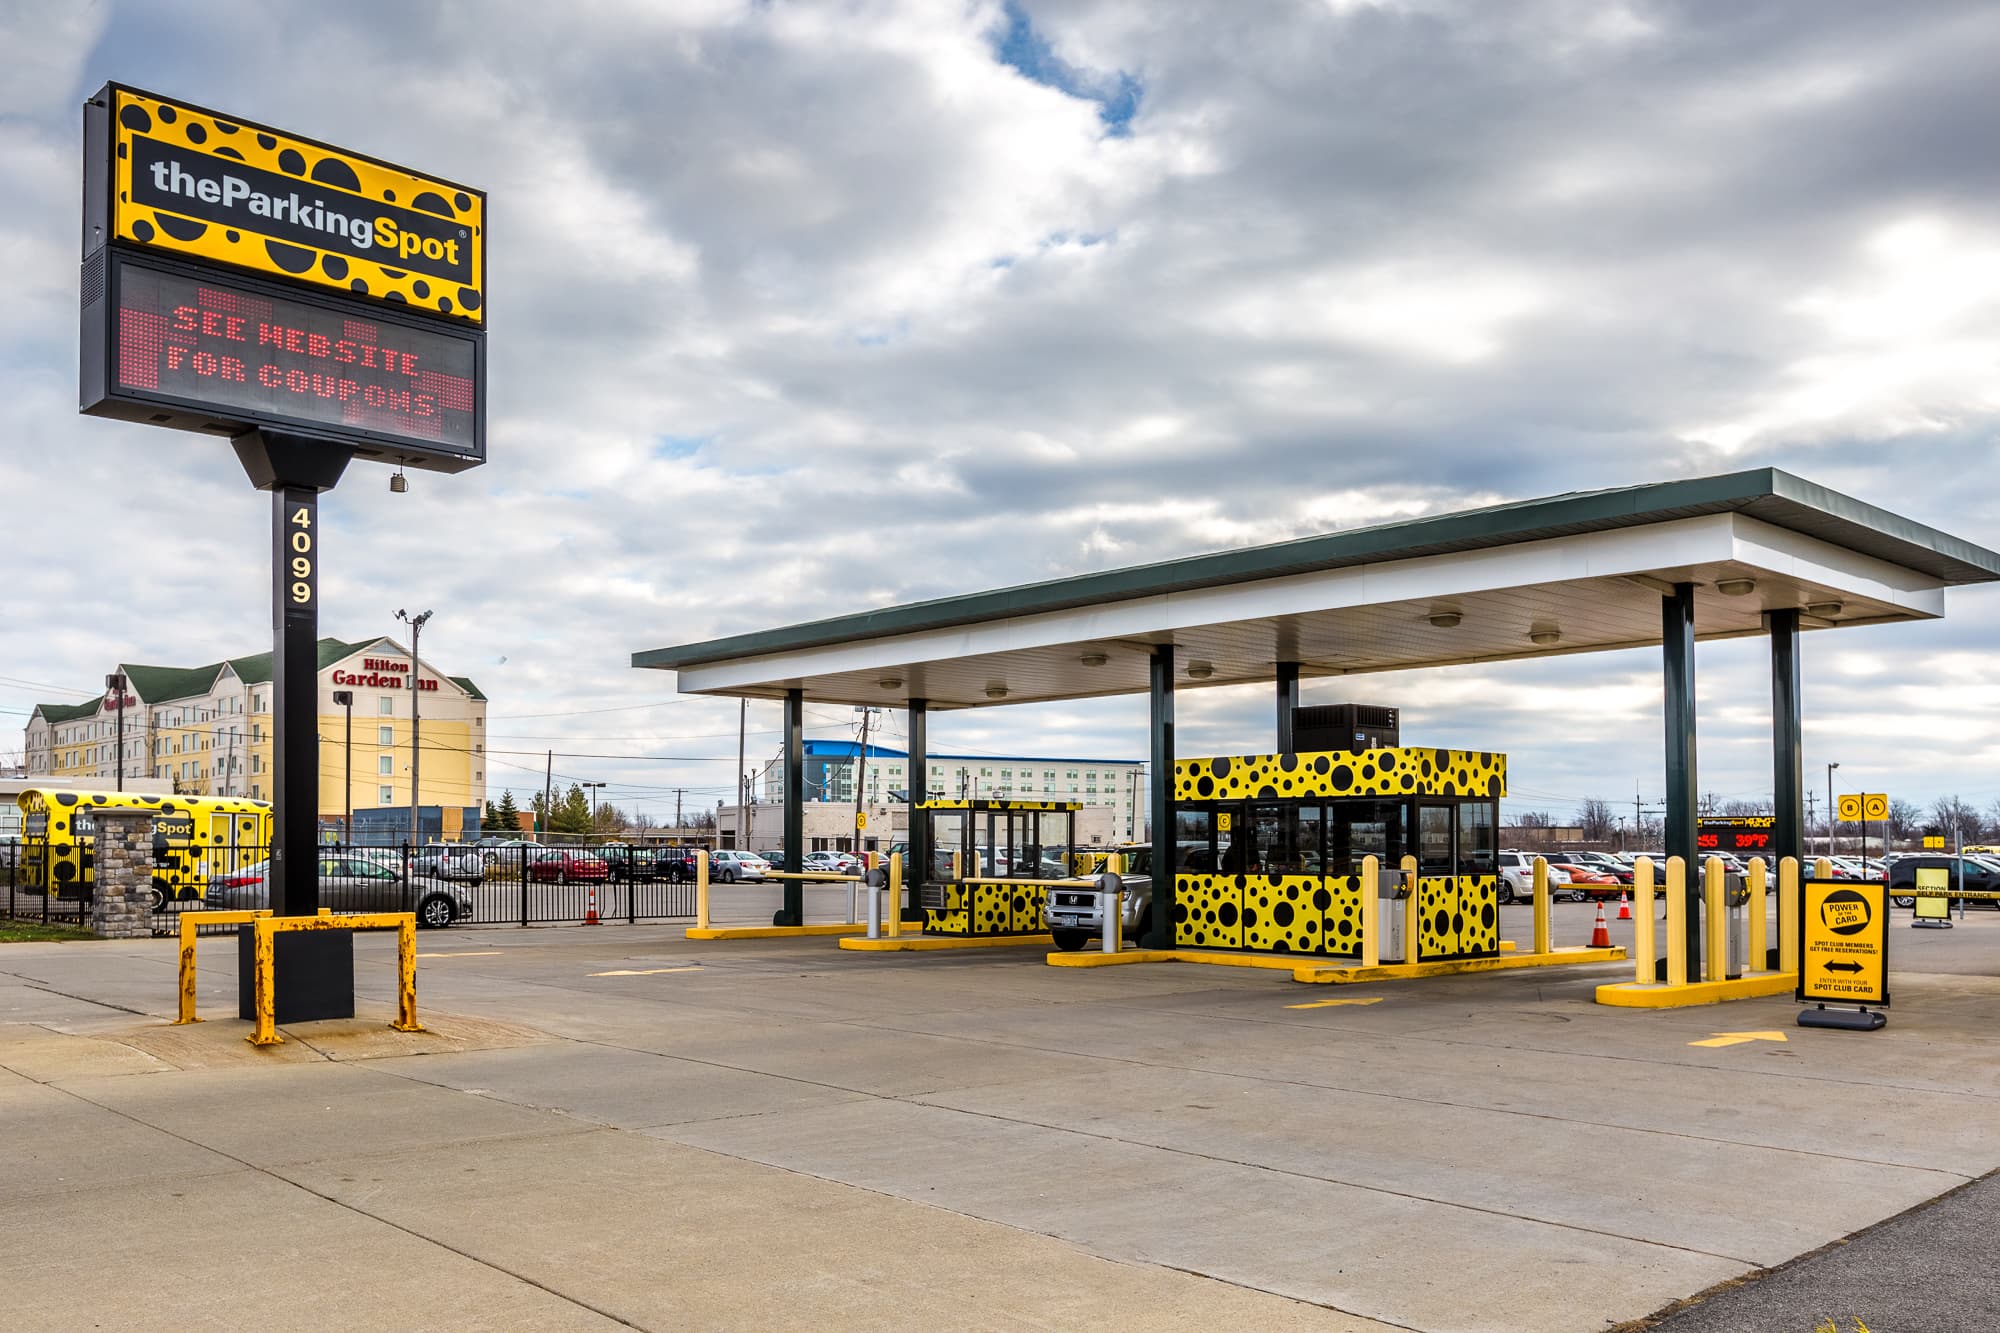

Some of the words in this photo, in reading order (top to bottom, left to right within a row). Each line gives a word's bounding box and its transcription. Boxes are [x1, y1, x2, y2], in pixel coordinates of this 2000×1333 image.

[150, 160, 459, 266] theParkingSpot
[173, 306, 246, 342] SEE
[168, 345, 245, 382] FOR
[258, 363, 434, 417] COUPONS
[291, 507, 311, 604] 4099
[363, 658, 409, 673] Hilton
[332, 669, 402, 689] Garden
[406, 674, 439, 691] Inn
[1846, 804, 1853, 812] B
[1872, 803, 1880, 811] A
[1735, 833, 1769, 847] 39°F
[1829, 904, 1858, 912] POWER
[1835, 915, 1858, 925] CARD
